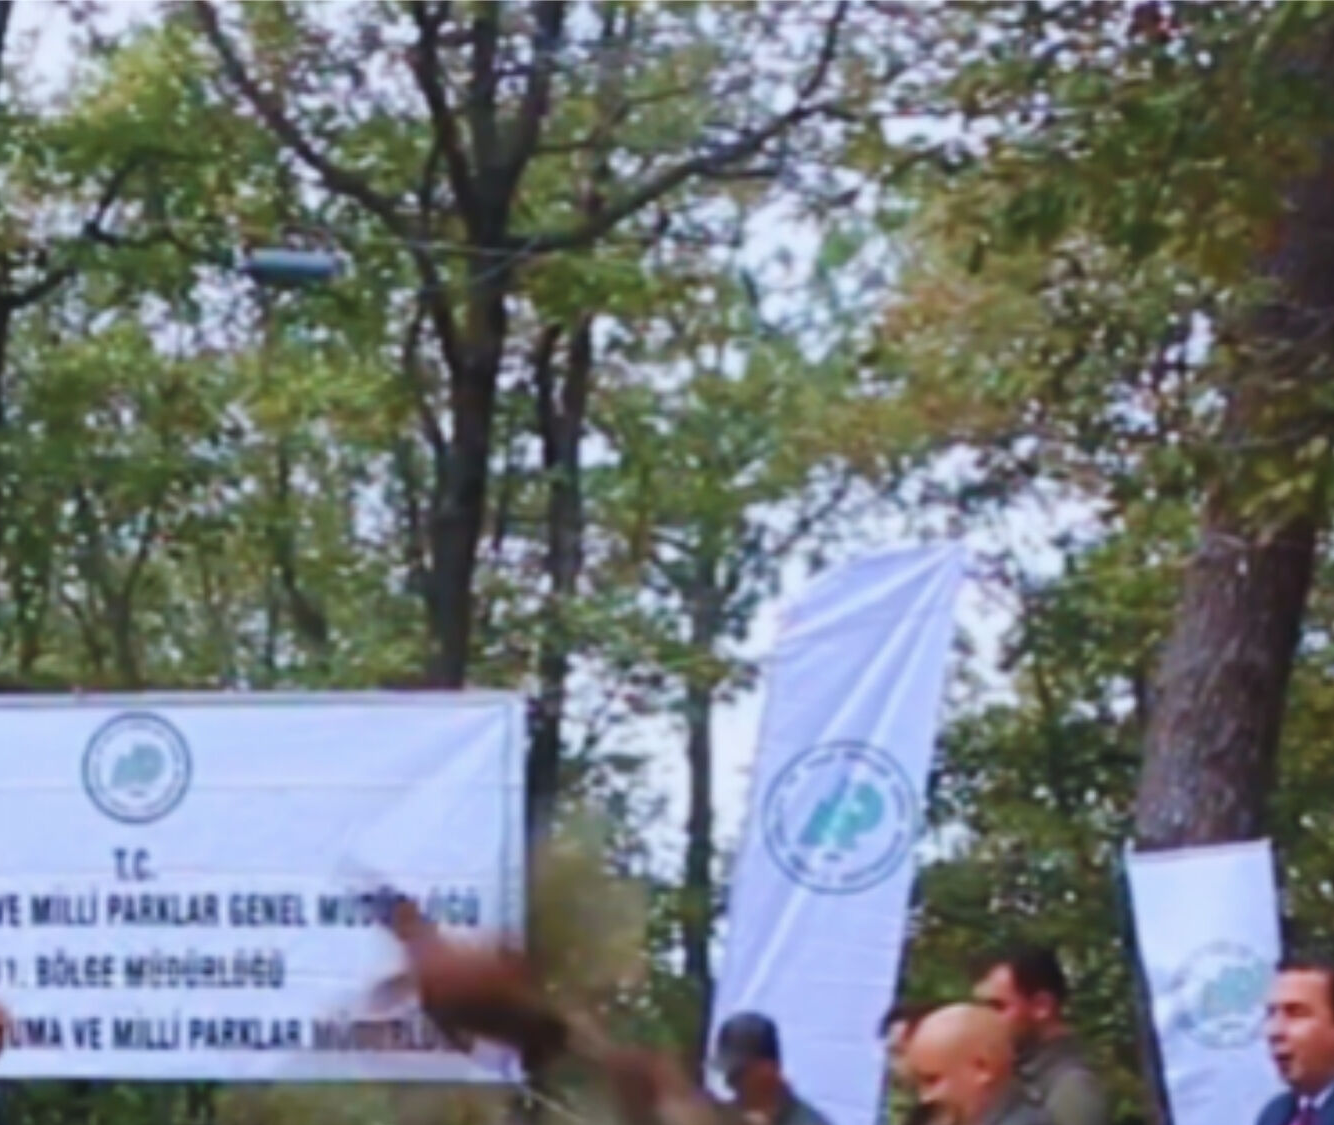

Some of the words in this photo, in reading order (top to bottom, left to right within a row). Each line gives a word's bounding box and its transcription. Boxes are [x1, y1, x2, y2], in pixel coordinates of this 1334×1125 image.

[113, 848, 156, 881] T.C.
[106, 894, 220, 927] PARKLAR
[228, 893, 308, 927] GENEL
[35, 949, 115, 988] BÖLGE
[123, 947, 285, 988] MÜDÜRLÜĞÜ
[71, 1016, 103, 1049] VE
[188, 1016, 302, 1049] PARKLAR
